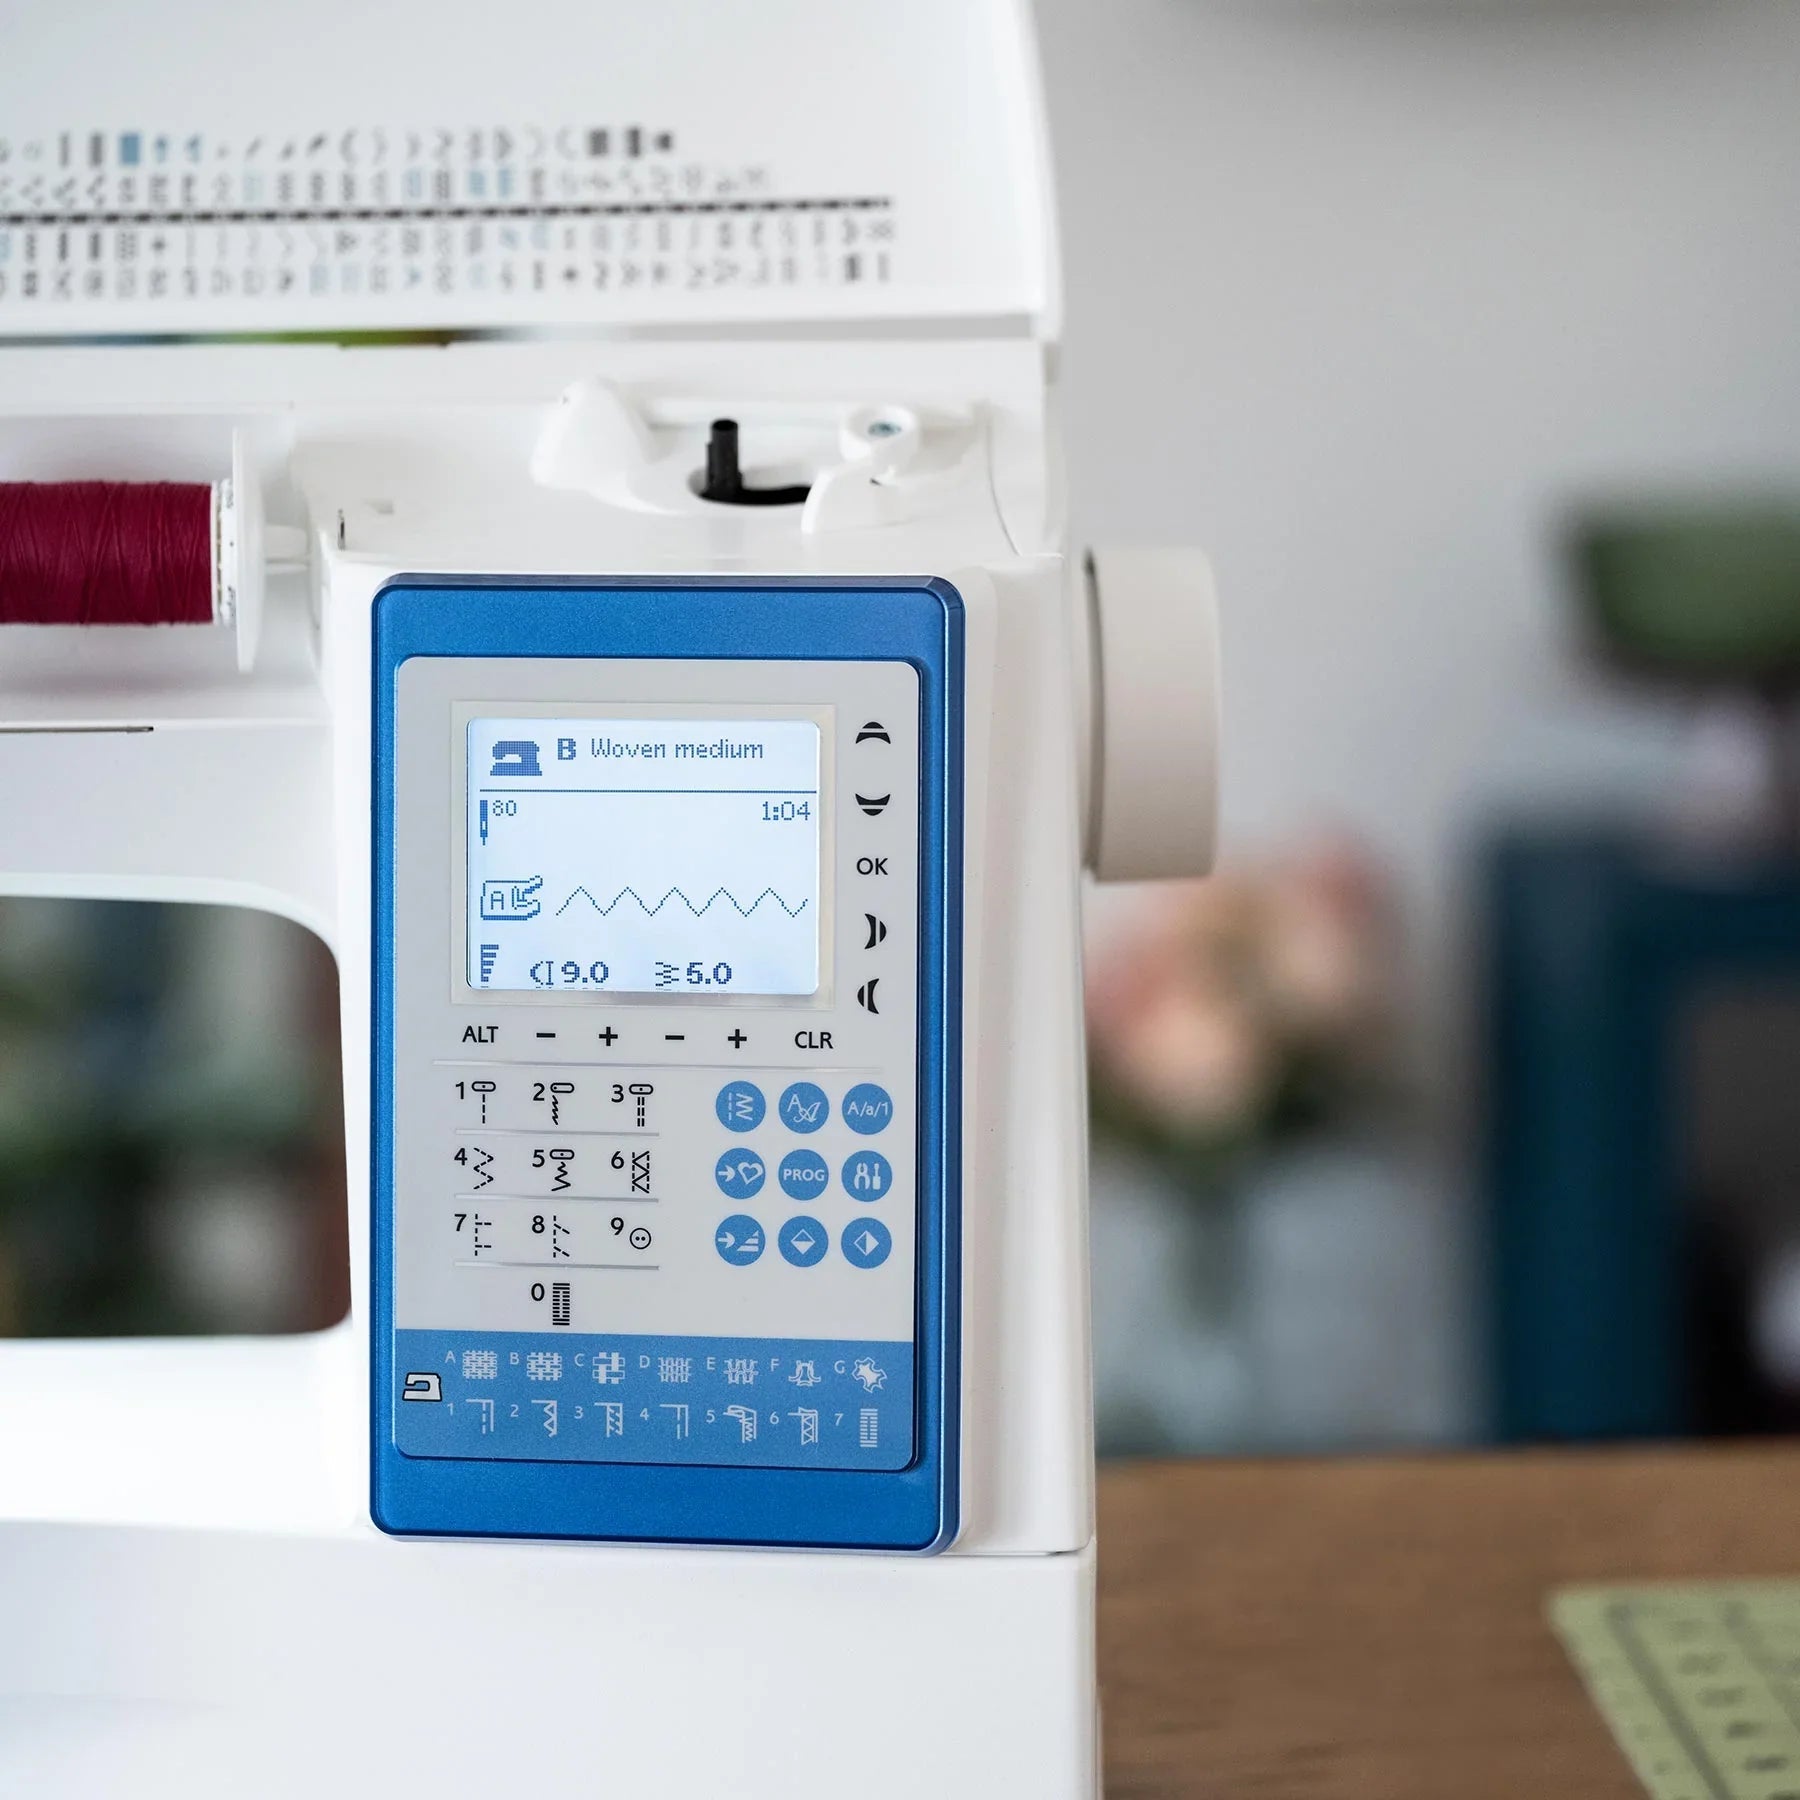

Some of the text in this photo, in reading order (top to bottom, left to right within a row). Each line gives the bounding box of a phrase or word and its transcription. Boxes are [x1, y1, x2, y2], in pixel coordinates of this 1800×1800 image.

[557, 738, 762, 761] B Woven medium
[493, 800, 516, 816] 80
[763, 801, 810, 820] 1:04
[857, 858, 888, 875] OK
[562, 961, 608, 983] 9.0
[687, 962, 731, 984] 5.0
[462, 1026, 498, 1043] ALT
[795, 1031, 833, 1049] CLR
[456, 1082, 464, 1099] 1
[533, 1083, 545, 1101] 2
[612, 1084, 624, 1102] 3
[847, 1101, 889, 1117] A/a/1
[454, 1148, 467, 1165] 4
[533, 1150, 545, 1167] 5
[611, 1151, 624, 1169] 6
[782, 1168, 826, 1182] PROG
[455, 1214, 466, 1231] 7
[532, 1215, 545, 1233] 8
[611, 1217, 624, 1235] 9
[531, 1283, 544, 1301] 0
[445, 1351, 455, 1363] A
[510, 1353, 519, 1365] B
[575, 1354, 584, 1366] C
[640, 1355, 650, 1368] D
[707, 1358, 716, 1370] E
[771, 1359, 779, 1371] F
[834, 1360, 846, 1374] G
[447, 1403, 453, 1415] 1
[511, 1404, 518, 1417] 2
[575, 1406, 583, 1419] 3
[640, 1408, 649, 1420] 4
[707, 1410, 715, 1422] 5
[770, 1412, 779, 1424] 6
[835, 1413, 843, 1425] 7
